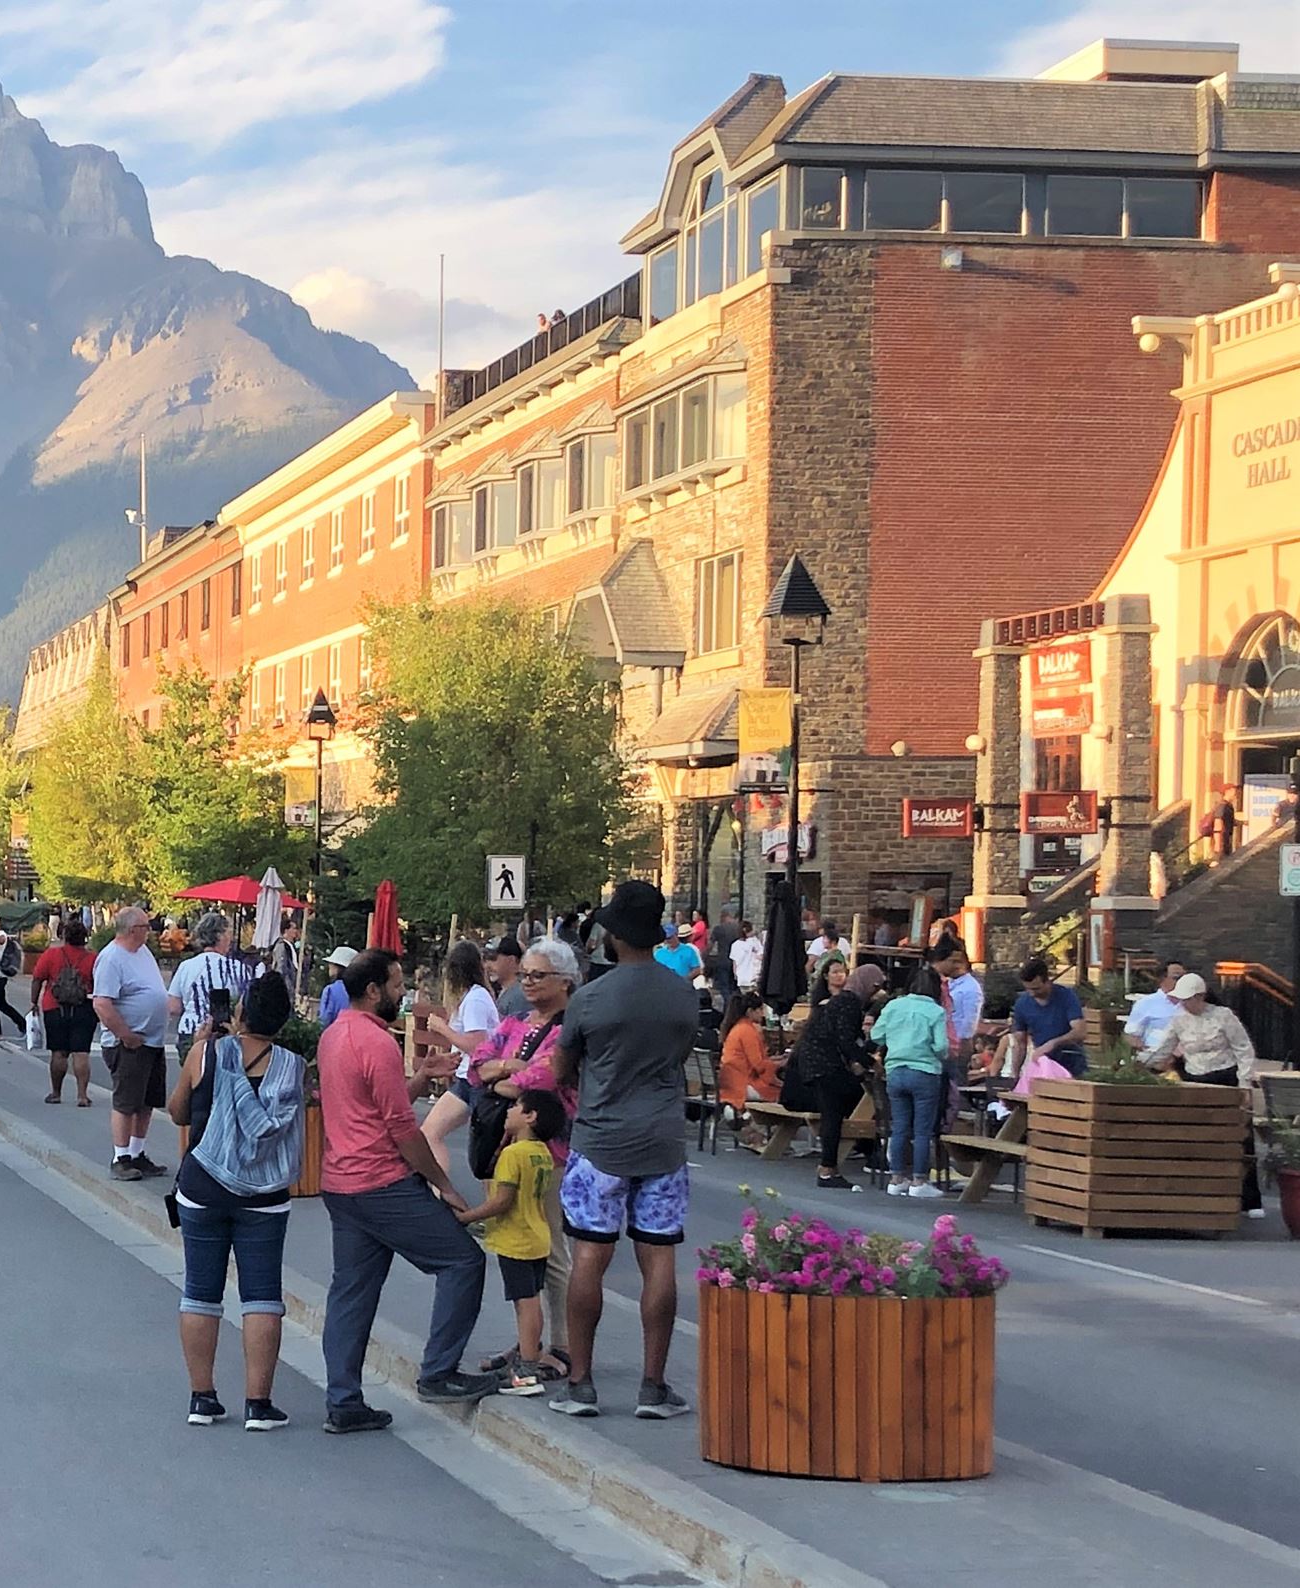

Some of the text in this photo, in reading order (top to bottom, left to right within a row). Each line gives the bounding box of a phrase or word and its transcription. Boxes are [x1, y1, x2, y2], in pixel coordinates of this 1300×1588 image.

[1246, 456, 1291, 488] HALL
[747, 702, 778, 713] Cave
[747, 714, 770, 725] and
[748, 727, 781, 738] Basin
[912, 808, 965, 822] BALKAN
